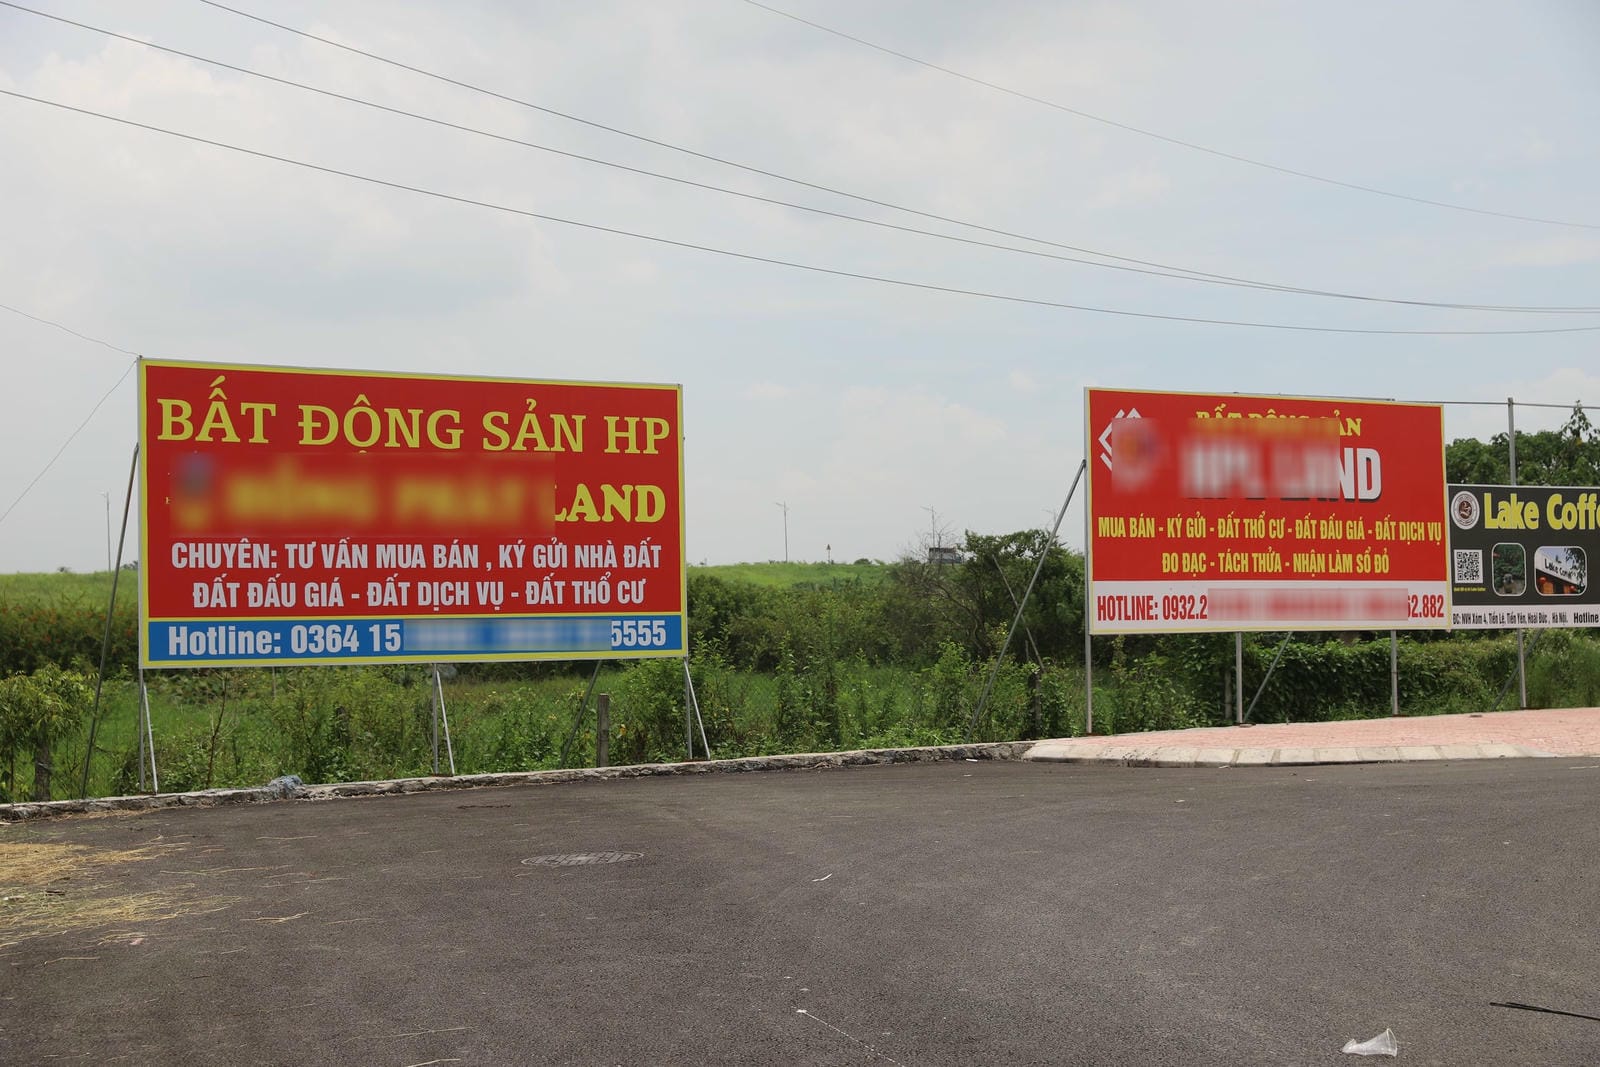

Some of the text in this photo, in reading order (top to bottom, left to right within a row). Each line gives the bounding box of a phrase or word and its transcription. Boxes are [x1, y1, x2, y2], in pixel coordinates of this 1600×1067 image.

[157, 375, 671, 455] BẤT ĐỘNG SẢN HP
[1098, 516, 1127, 538] MUA
[1129, 512, 1156, 538] BÁN
[1166, 513, 1184, 538] KÝ
[1185, 511, 1207, 539] GỬI
[1217, 510, 1241, 539] ĐẤT
[1242, 510, 1267, 539] THỔ
[1268, 516, 1286, 540] CƯ
[1294, 512, 1318, 540] ĐẤT
[1319, 512, 1344, 540] ĐẤU
[1345, 516, 1366, 540] GIÁ
[1374, 514, 1397, 541] ĐẤT
[1398, 520, 1426, 545] DỊCH
[1427, 520, 1442, 546] VỤ
[1484, 492, 1540, 530] Lake
[1546, 493, 1600, 530] Coff
[171, 537, 278, 569] CHUYÊN:
[284, 541, 318, 569] TƯ
[320, 536, 369, 569] VẤN
[375, 543, 427, 569] MUA
[433, 538, 479, 569] BÁN
[498, 539, 526, 569] KÝ
[532, 536, 569, 569] GỬI
[574, 539, 618, 569] NHÀ
[622, 536, 662, 569] ĐẤT
[1161, 552, 1180, 573] ĐO
[1181, 552, 1207, 578] ĐẠC
[1217, 548, 1249, 573] TÁCH
[1251, 546, 1283, 573] THỬA
[1292, 548, 1326, 578] NHẬN
[1328, 549, 1353, 574] LÀM
[1355, 546, 1372, 574] SỔ
[1373, 547, 1390, 574] ĐỎ
[192, 573, 241, 608] ĐẤT
[246, 573, 297, 608] ĐẤU
[304, 576, 345, 608] GIÁ
[366, 572, 411, 607] ĐẤT
[417, 580, 470, 612] DỊCH
[475, 580, 505, 611] VỤ
[525, 572, 566, 605] ĐẤT
[571, 571, 612, 605] THỔ
[617, 578, 647, 604] CƯ
[1097, 595, 1159, 622] HOTLINE:
[168, 624, 282, 656] Hotline:
[290, 624, 360, 654] 0364
